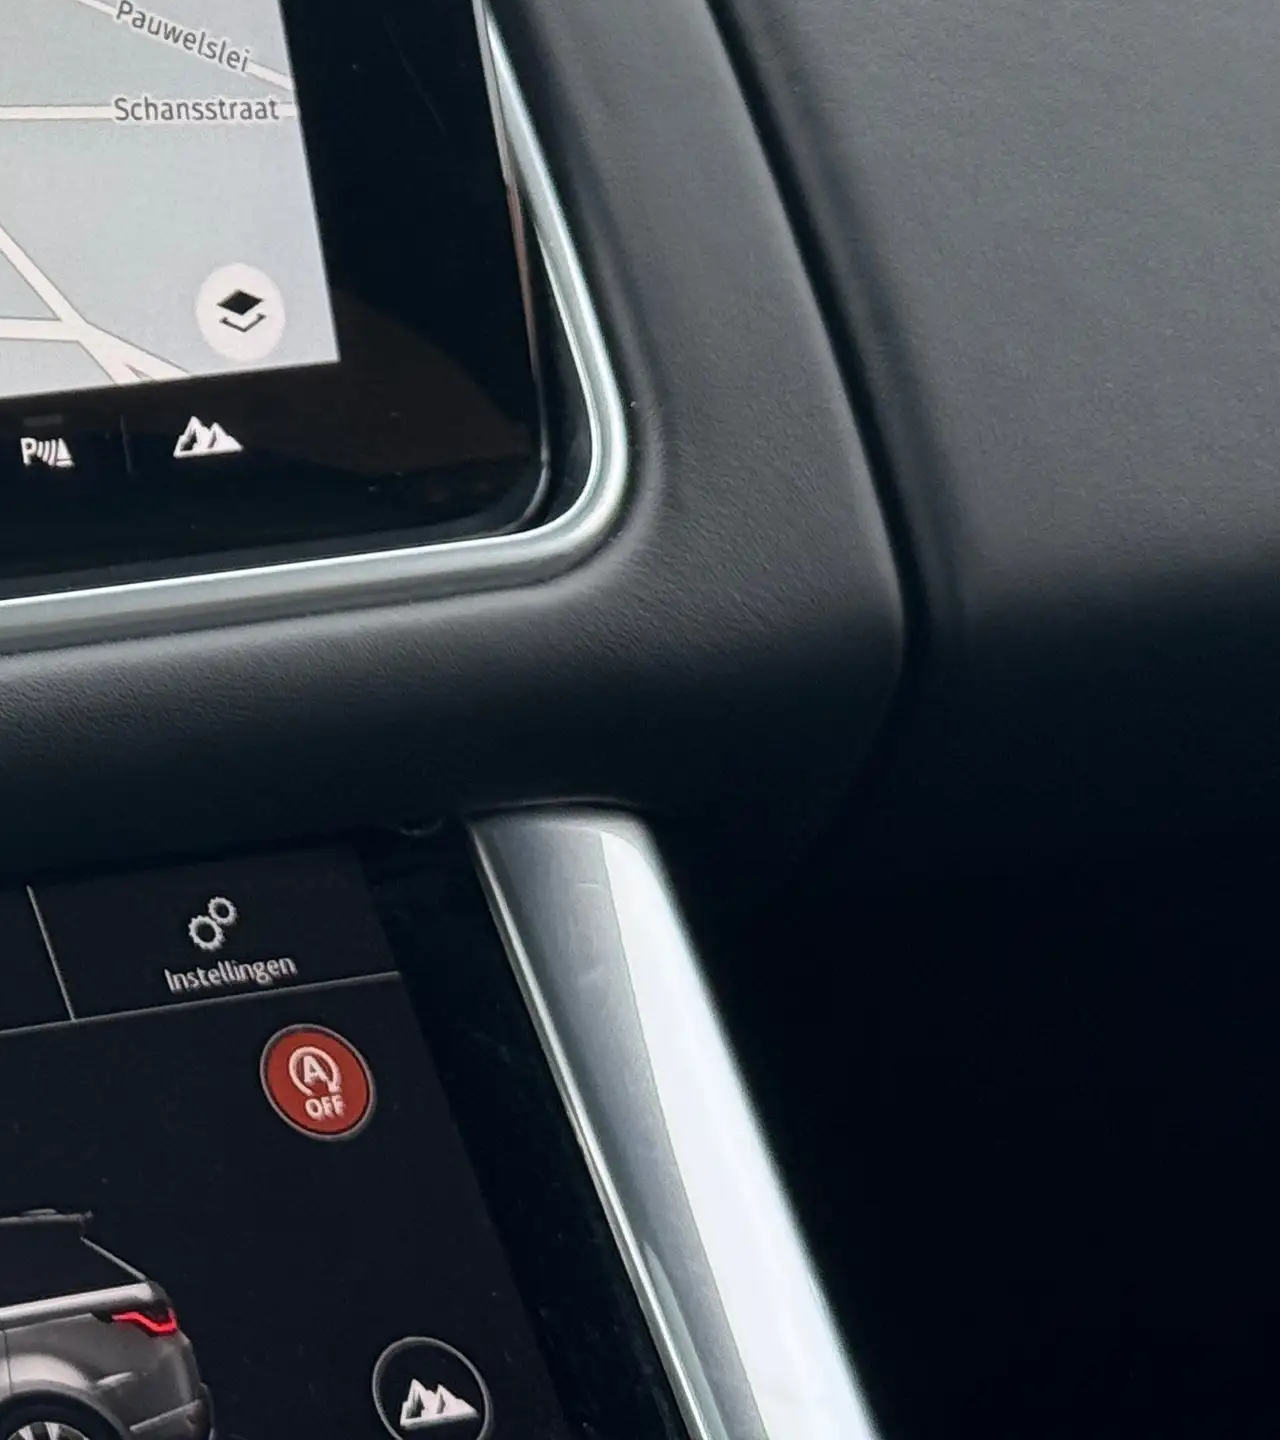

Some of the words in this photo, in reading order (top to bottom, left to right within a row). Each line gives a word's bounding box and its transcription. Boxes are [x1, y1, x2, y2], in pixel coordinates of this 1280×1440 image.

[116, 0, 251, 72] Pauwelslei
[114, 96, 280, 122] Schansstraat
[165, 954, 298, 992] Instellingen
[305, 1095, 344, 1120] OFF
